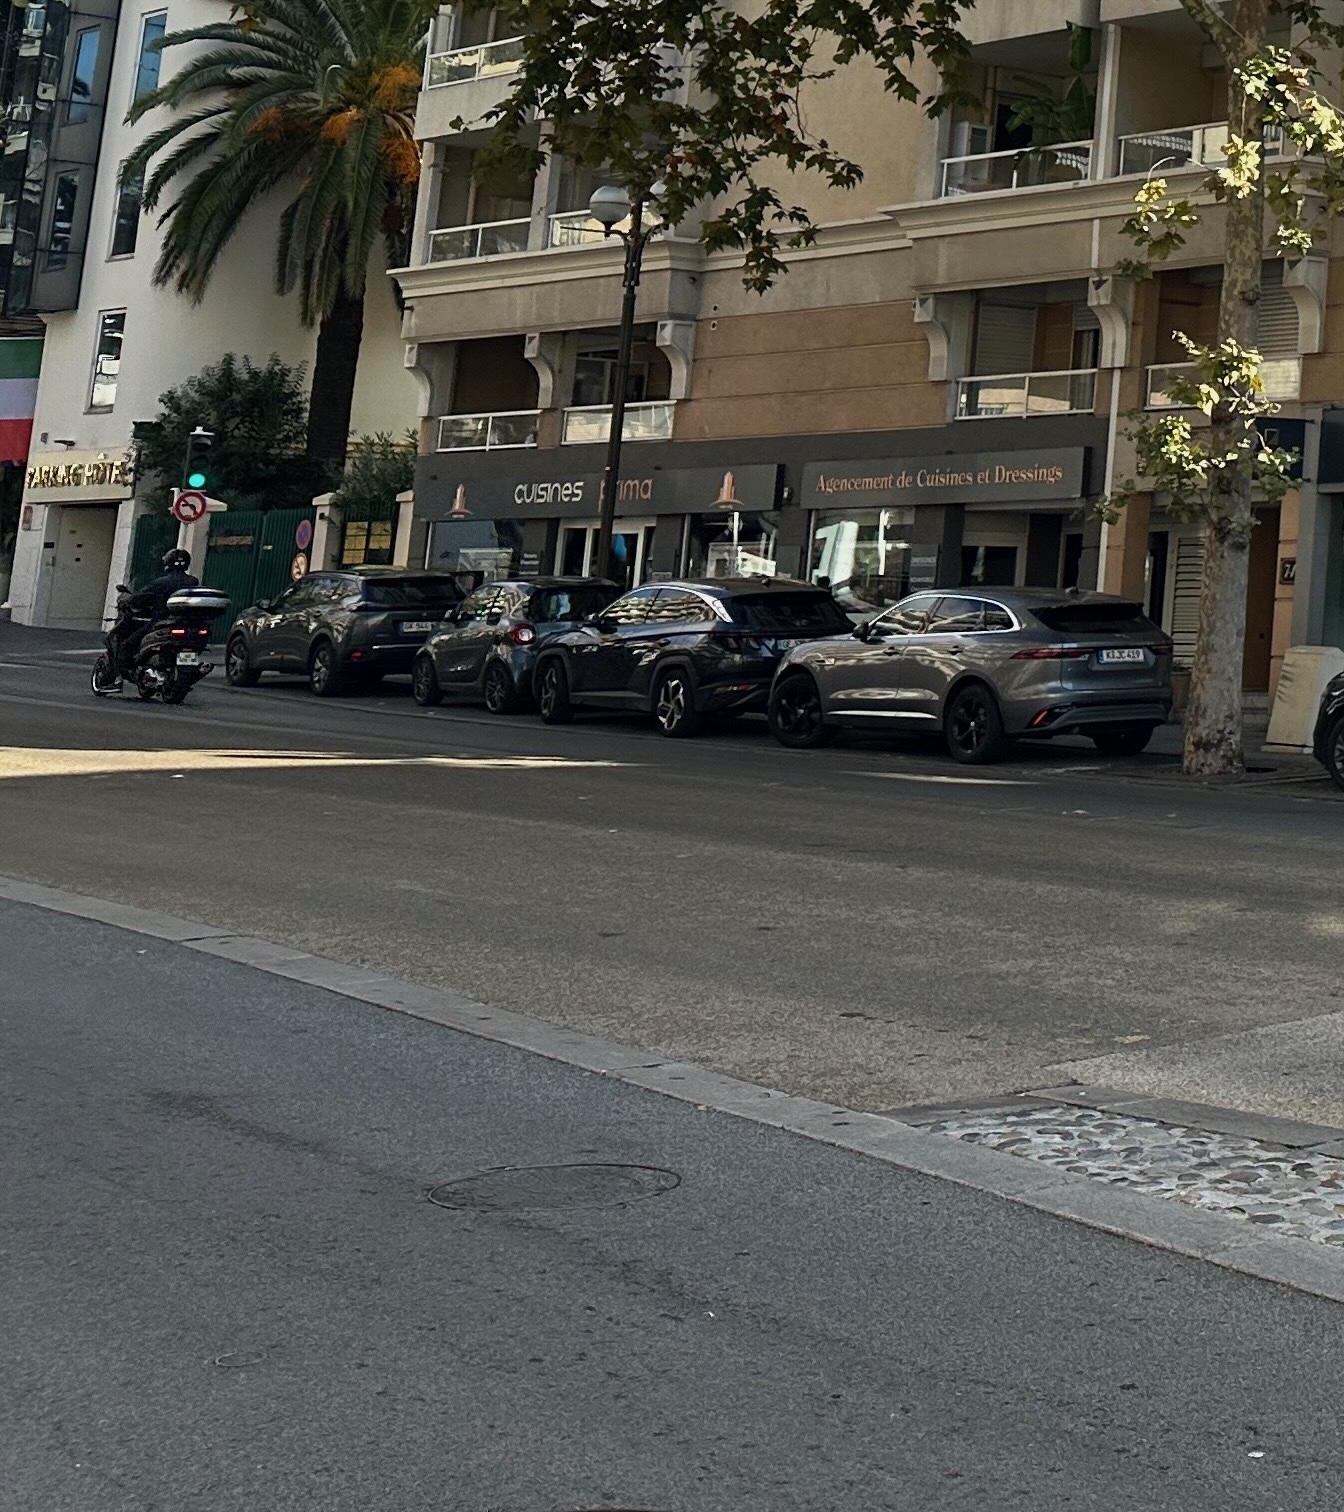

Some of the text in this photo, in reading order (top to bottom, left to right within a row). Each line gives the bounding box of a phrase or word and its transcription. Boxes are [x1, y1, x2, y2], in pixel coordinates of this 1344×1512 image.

[27, 464, 82, 489] PARKING
[815, 463, 1063, 495] Agencement de Cuisines et Dressings
[598, 479, 653, 512] ima
